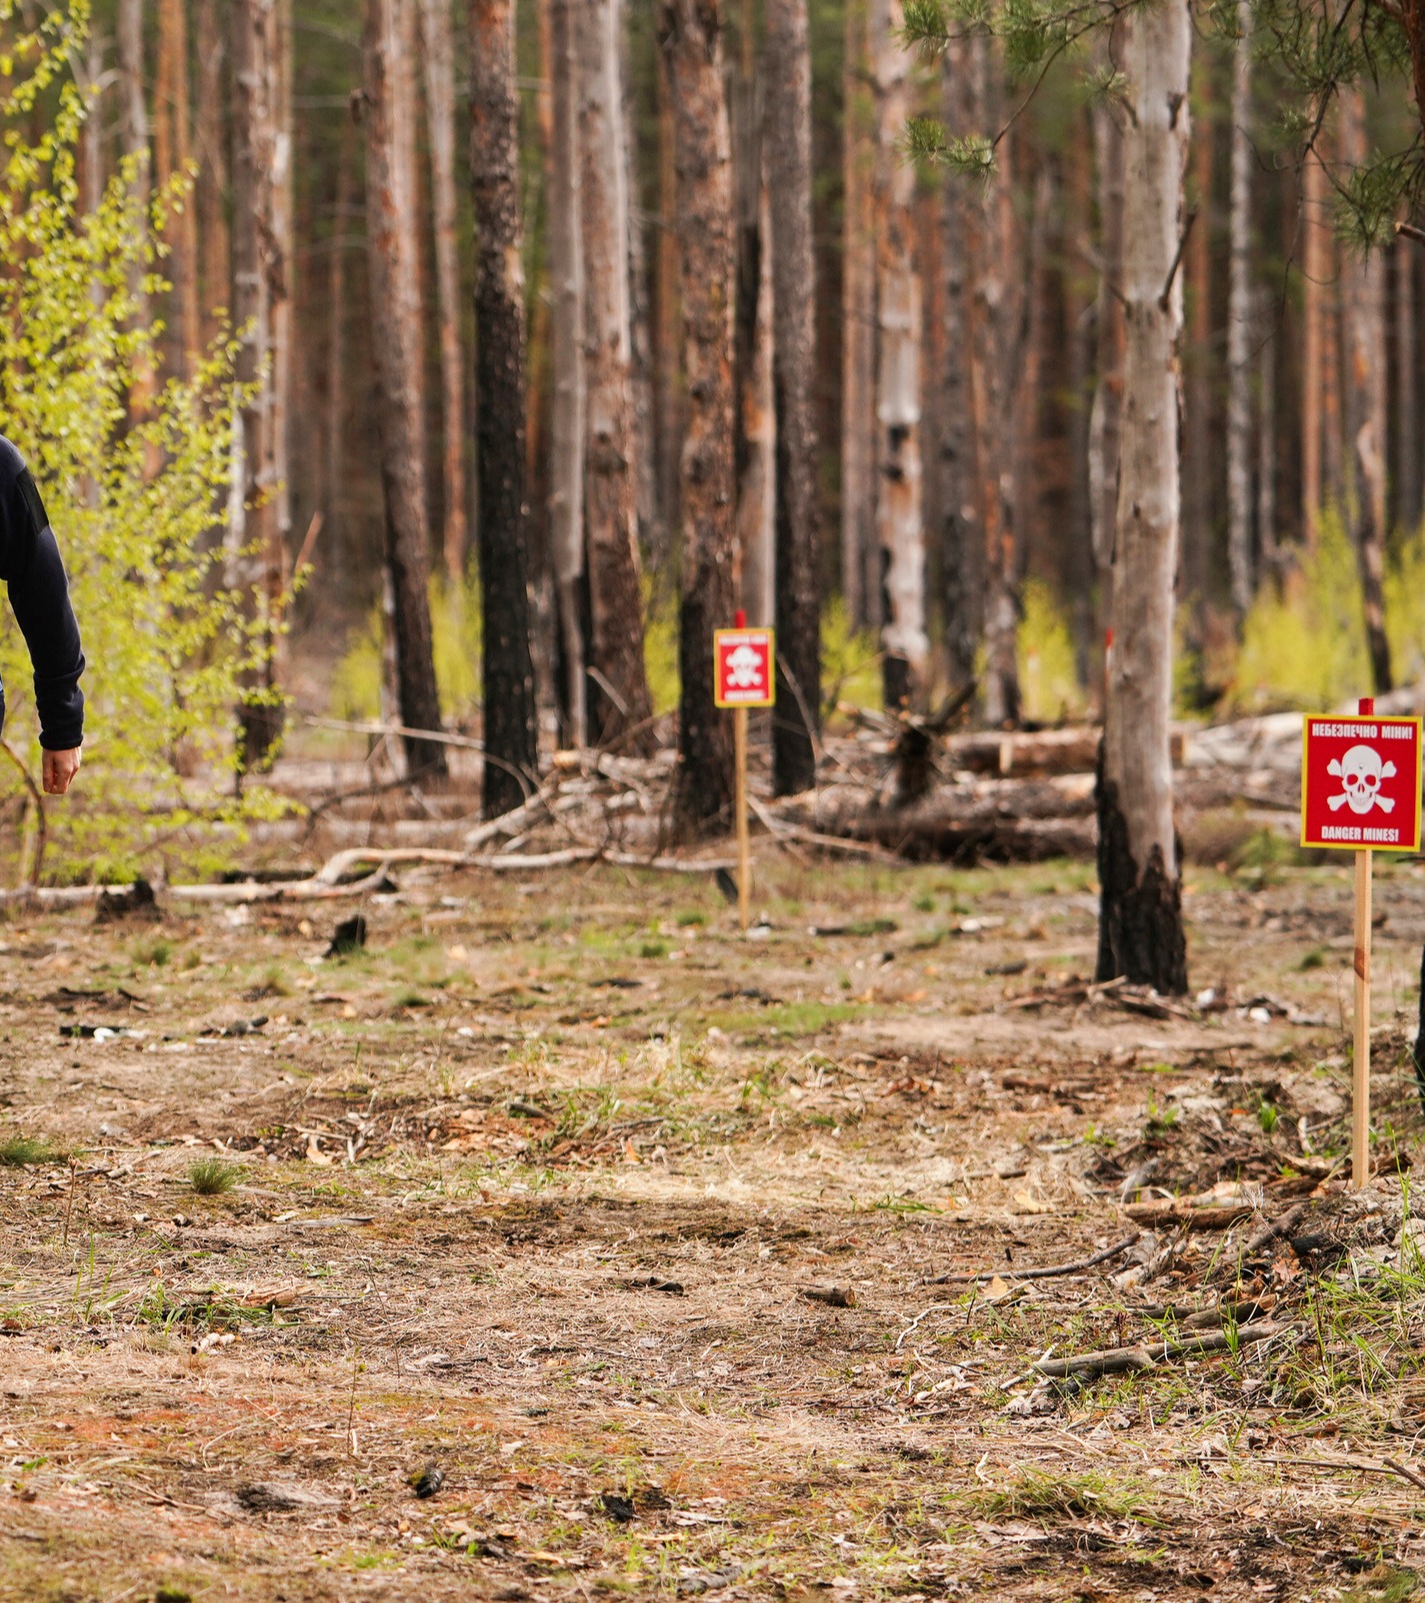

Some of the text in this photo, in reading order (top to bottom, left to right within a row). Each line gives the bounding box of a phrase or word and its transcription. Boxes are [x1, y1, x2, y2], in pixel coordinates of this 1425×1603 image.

[1312, 723, 1413, 739] НЕБЕЗПЕЧНО МІНИ!
[1321, 826, 1399, 842] DANGER MINES!
